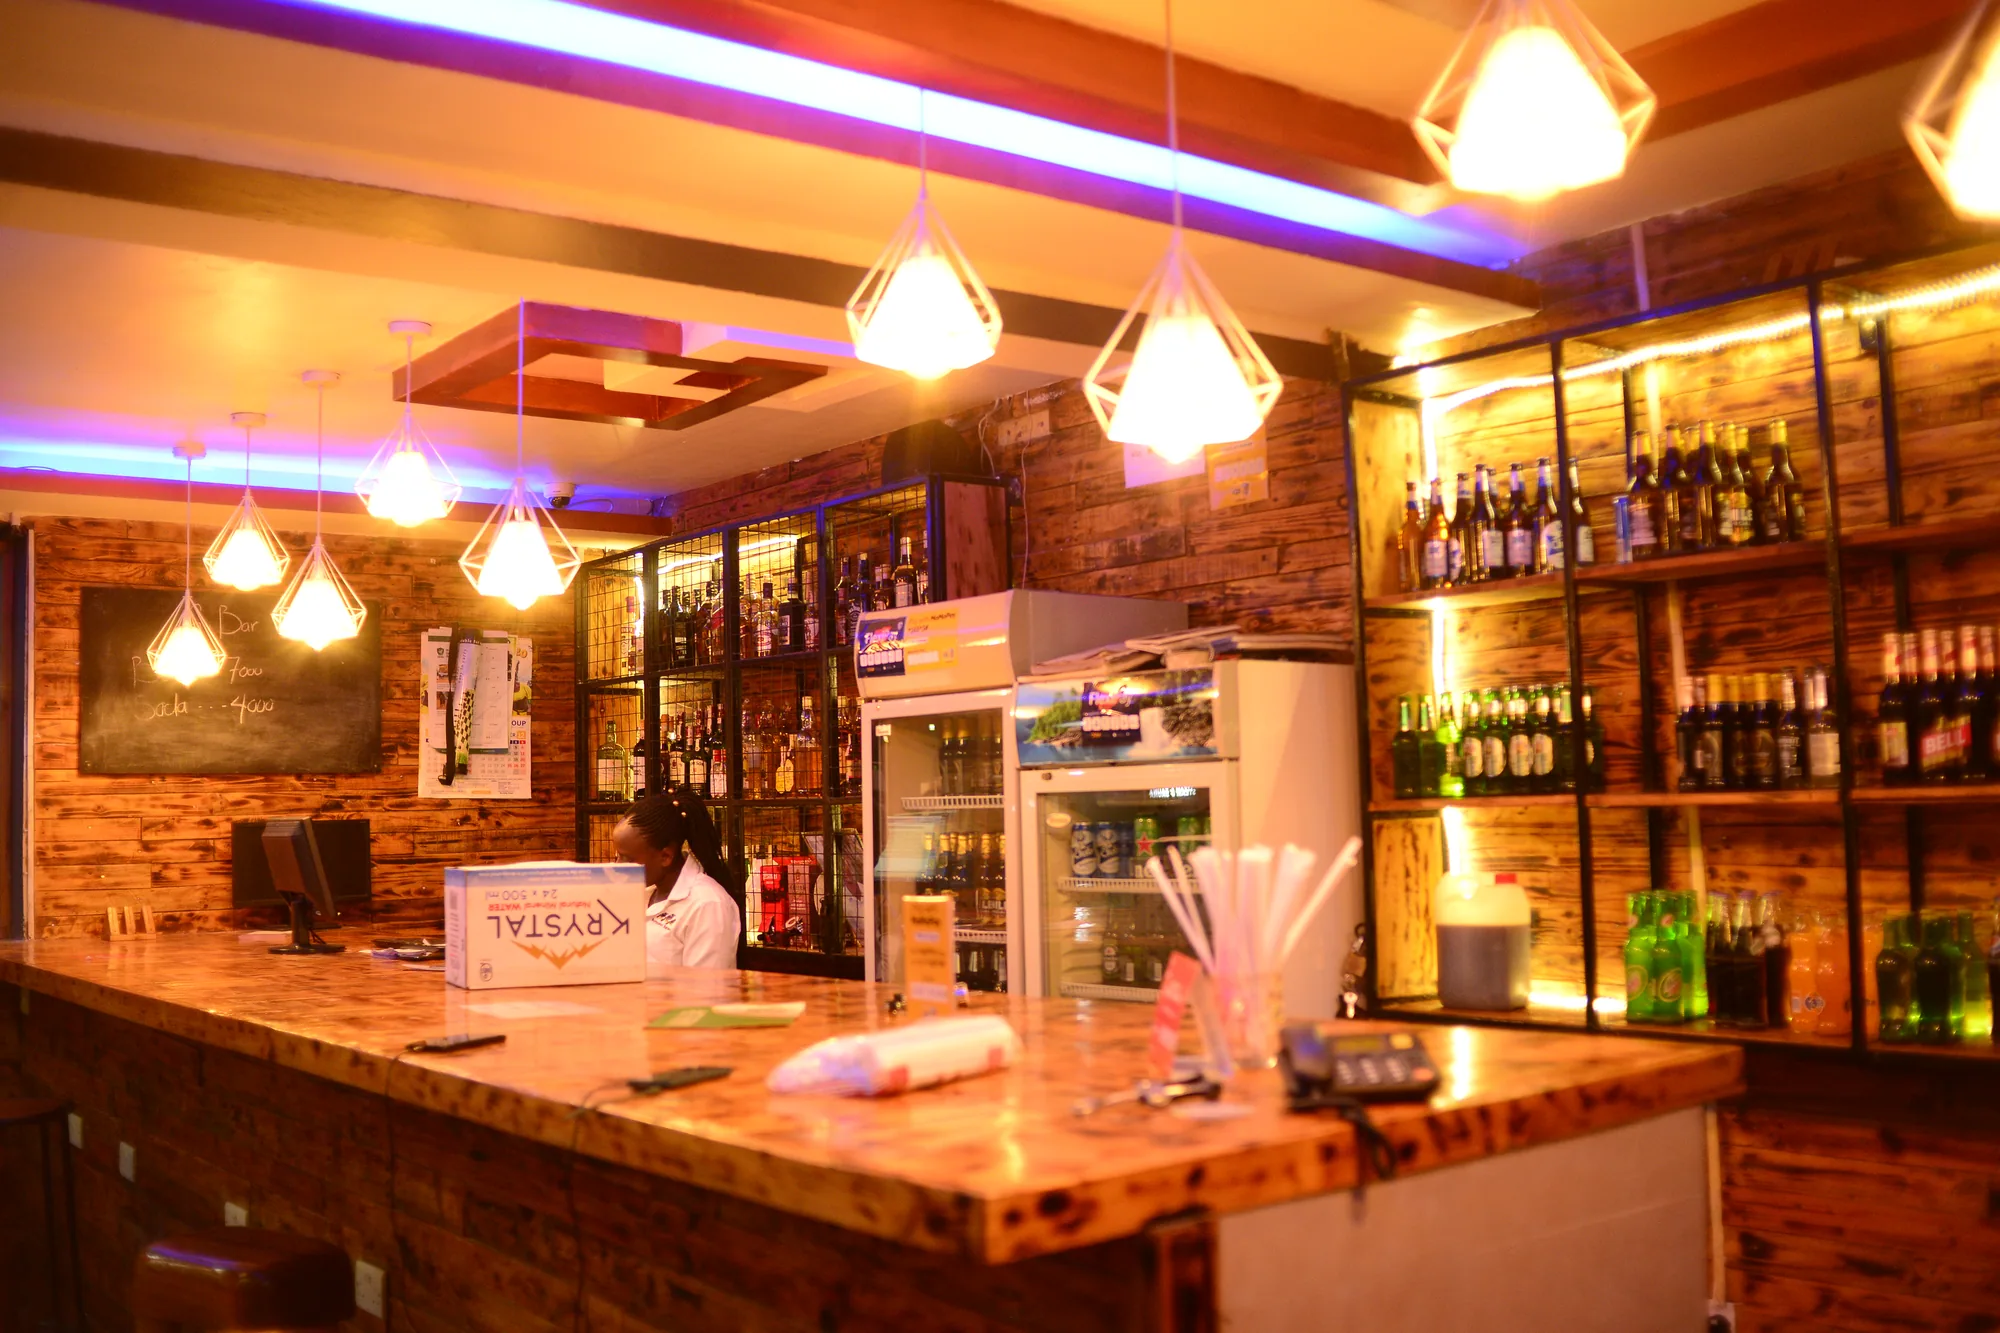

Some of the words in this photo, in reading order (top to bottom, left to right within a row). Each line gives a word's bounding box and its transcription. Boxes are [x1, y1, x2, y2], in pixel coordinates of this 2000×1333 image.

[218, 604, 259, 639] Bar
[226, 656, 263, 685] 7000
[134, 692, 188, 721] Soda
[230, 693, 275, 724] 4000
[511, 719, 527, 727] OUP
[1925, 727, 1966, 755] BELL
[485, 890, 500, 901] ml
[502, 889, 527, 900] 500
[542, 888, 558, 900] 24
[488, 902, 522, 912] WATER
[523, 901, 557, 911] Mineral
[558, 900, 592, 911] Natural
[487, 899, 630, 939] KRYSTAL
